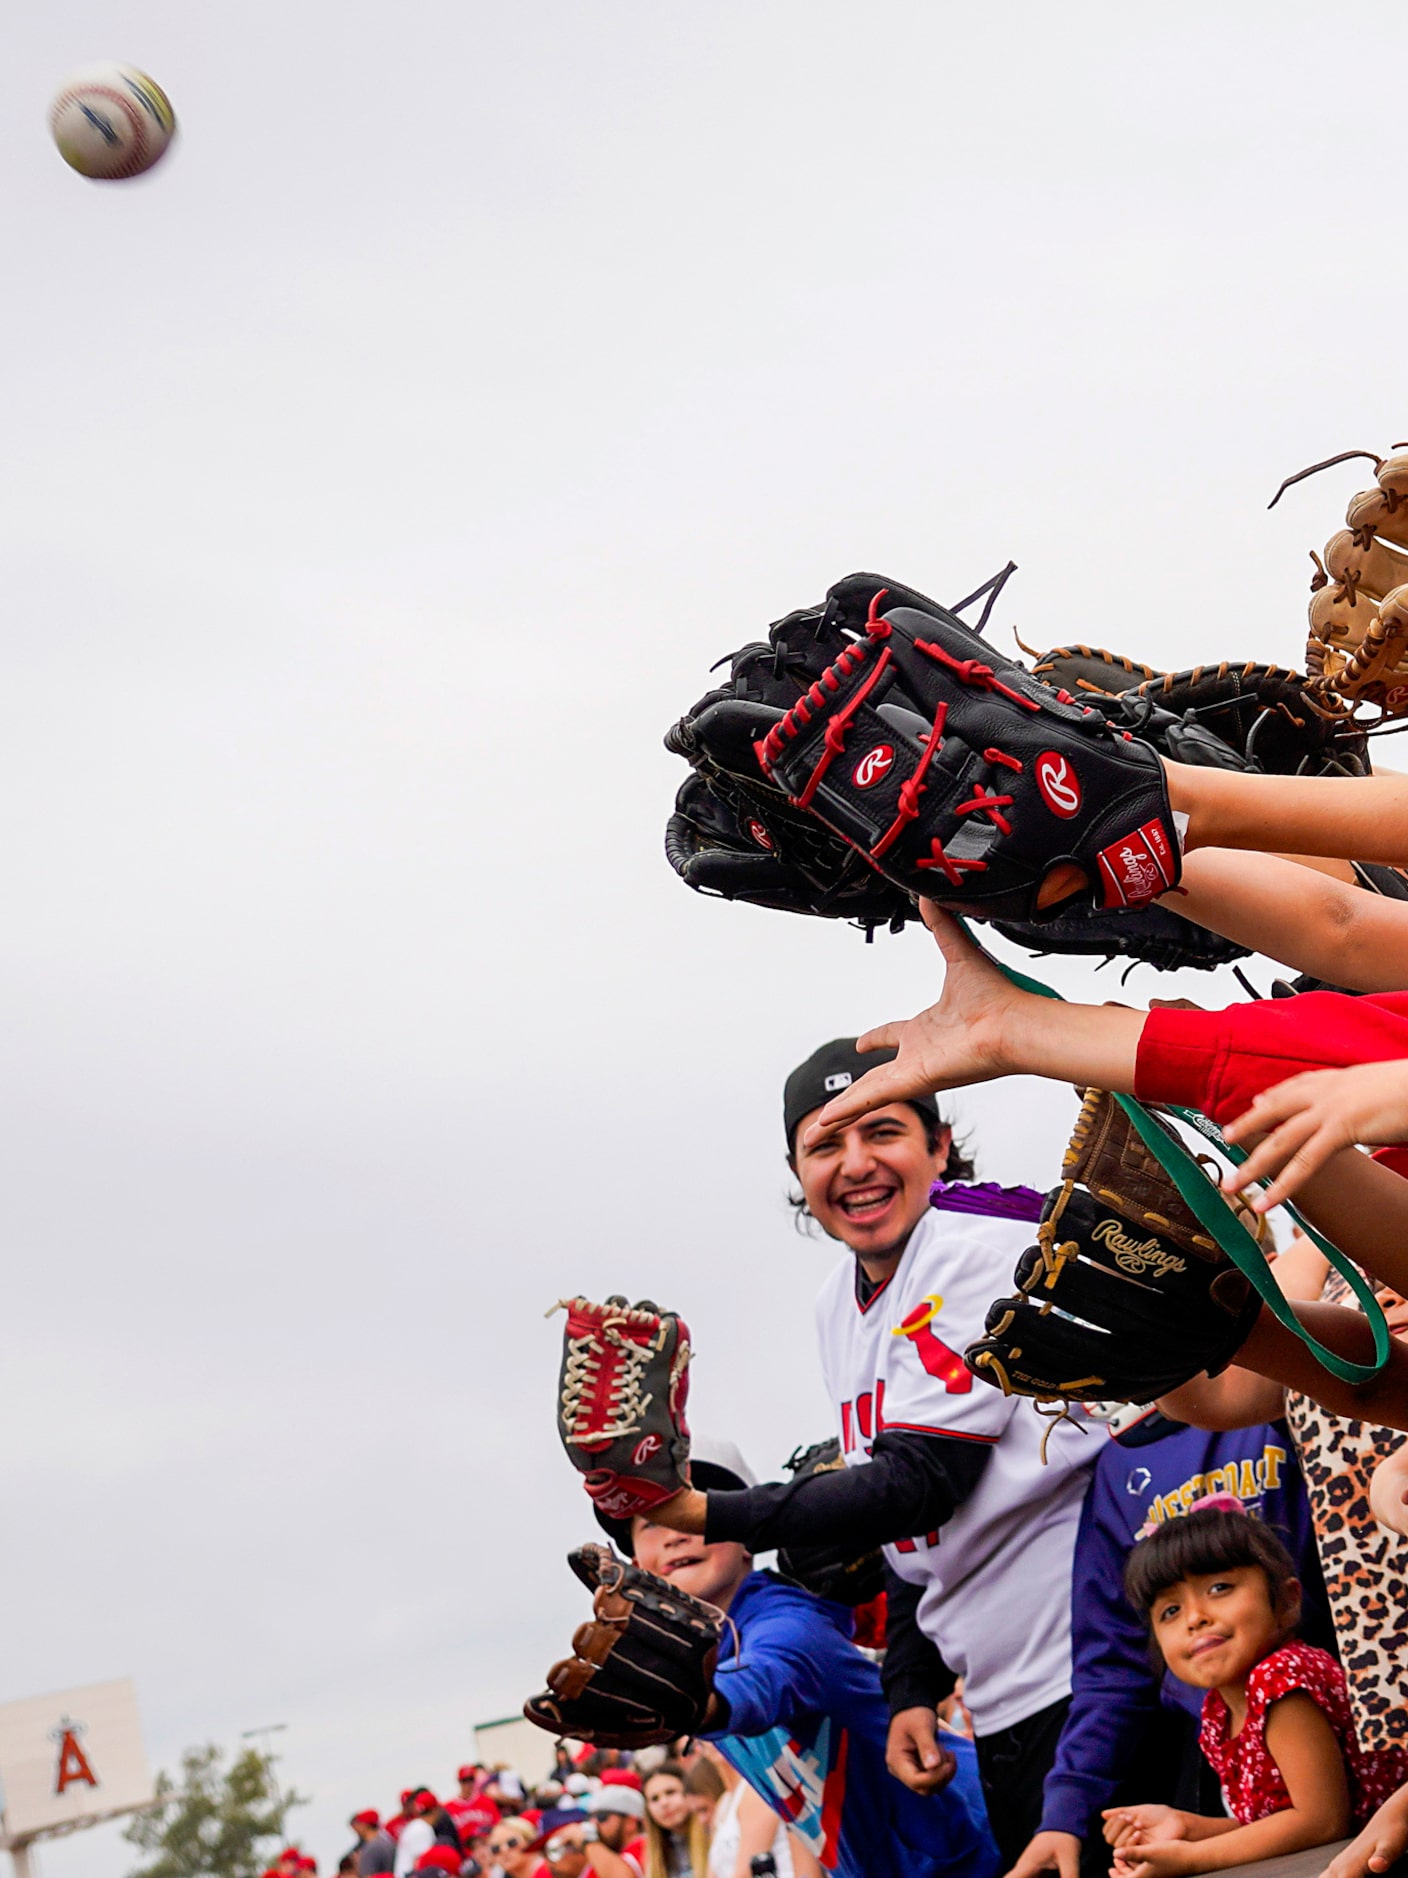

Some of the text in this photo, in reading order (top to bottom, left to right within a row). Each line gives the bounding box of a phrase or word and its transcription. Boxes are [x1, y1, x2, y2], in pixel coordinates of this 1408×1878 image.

[1039, 753, 1077, 812] R
[1091, 1219, 1187, 1279] Rawlings
[55, 1729, 98, 1794] A
